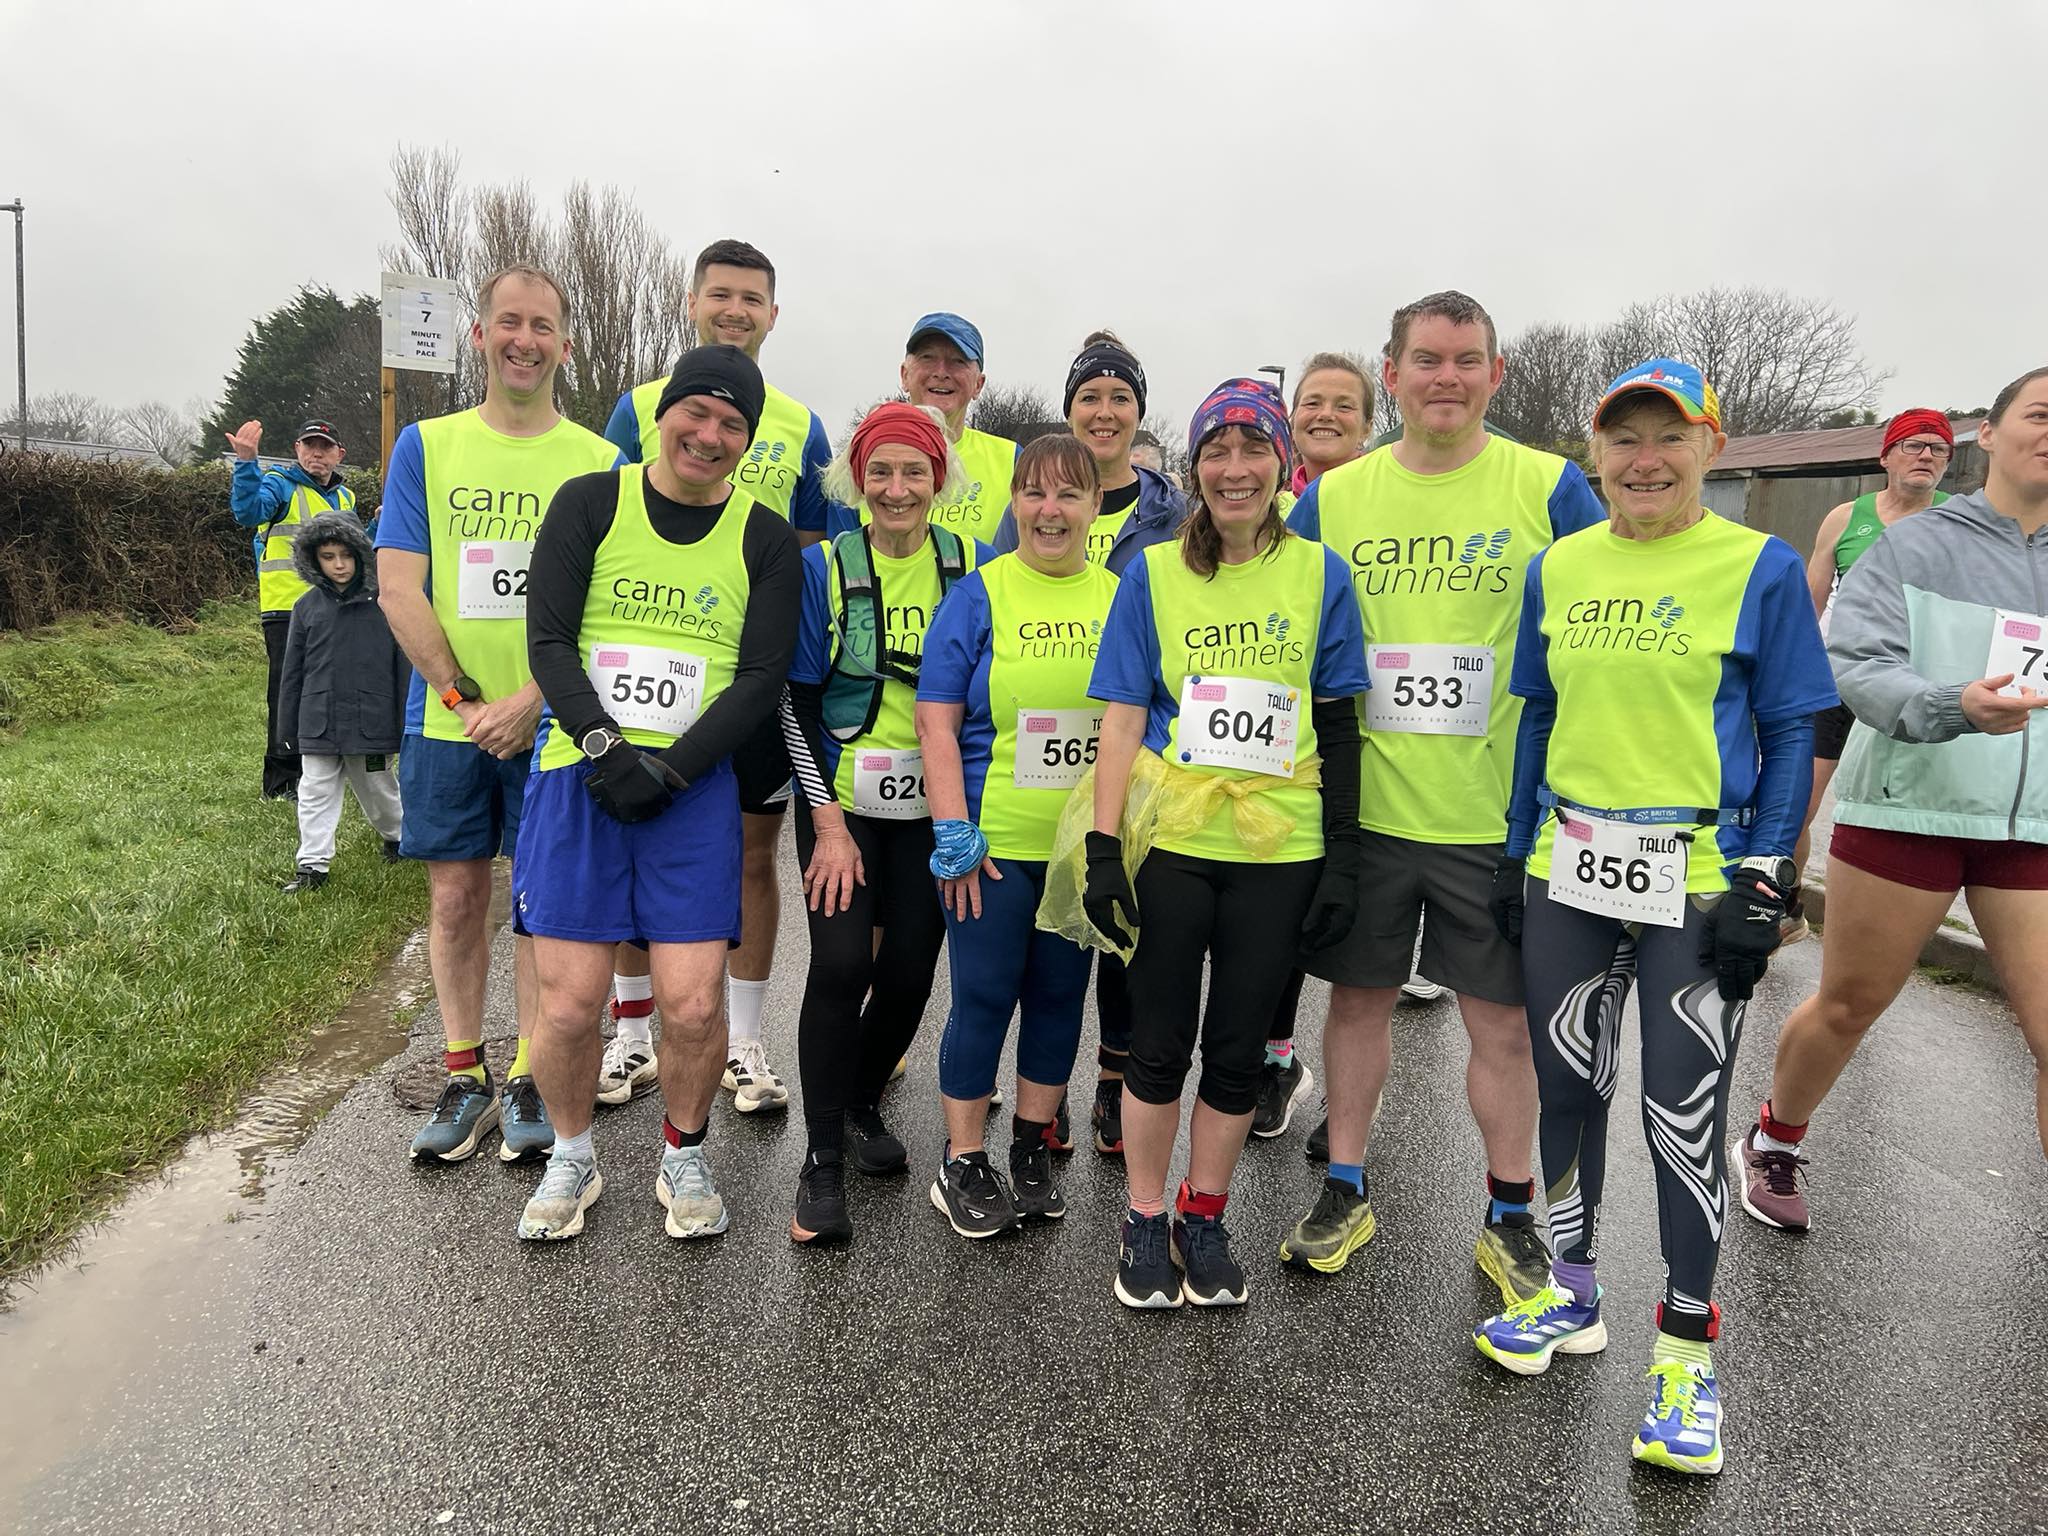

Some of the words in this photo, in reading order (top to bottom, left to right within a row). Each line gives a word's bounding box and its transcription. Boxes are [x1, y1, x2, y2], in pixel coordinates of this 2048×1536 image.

[421, 310, 431, 323] 7
[411, 330, 441, 339] MINUTE
[417, 340, 435, 348] MILE
[416, 349, 436, 357] PACE
[448, 487, 540, 517] carn
[1350, 535, 1455, 567] carn
[613, 578, 686, 609] carn
[1353, 564, 1513, 596] runners
[611, 600, 723, 639] runners
[1567, 599, 1644, 625] carn
[1019, 621, 1086, 640] carn
[1184, 620, 1259, 650] carn
[1558, 626, 1693, 656] runners
[668, 660, 697, 678] TALLO
[1187, 641, 1303, 672] runners
[1453, 656, 1483, 672] TALLO
[611, 674, 677, 709] 550
[1267, 693, 1293, 712] TALLO
[1393, 676, 1463, 709] 533
[1208, 708, 1275, 747] 604
[1042, 737, 1100, 767] 565
[1638, 837, 1677, 854] TALLO
[1576, 849, 1651, 894] 856
